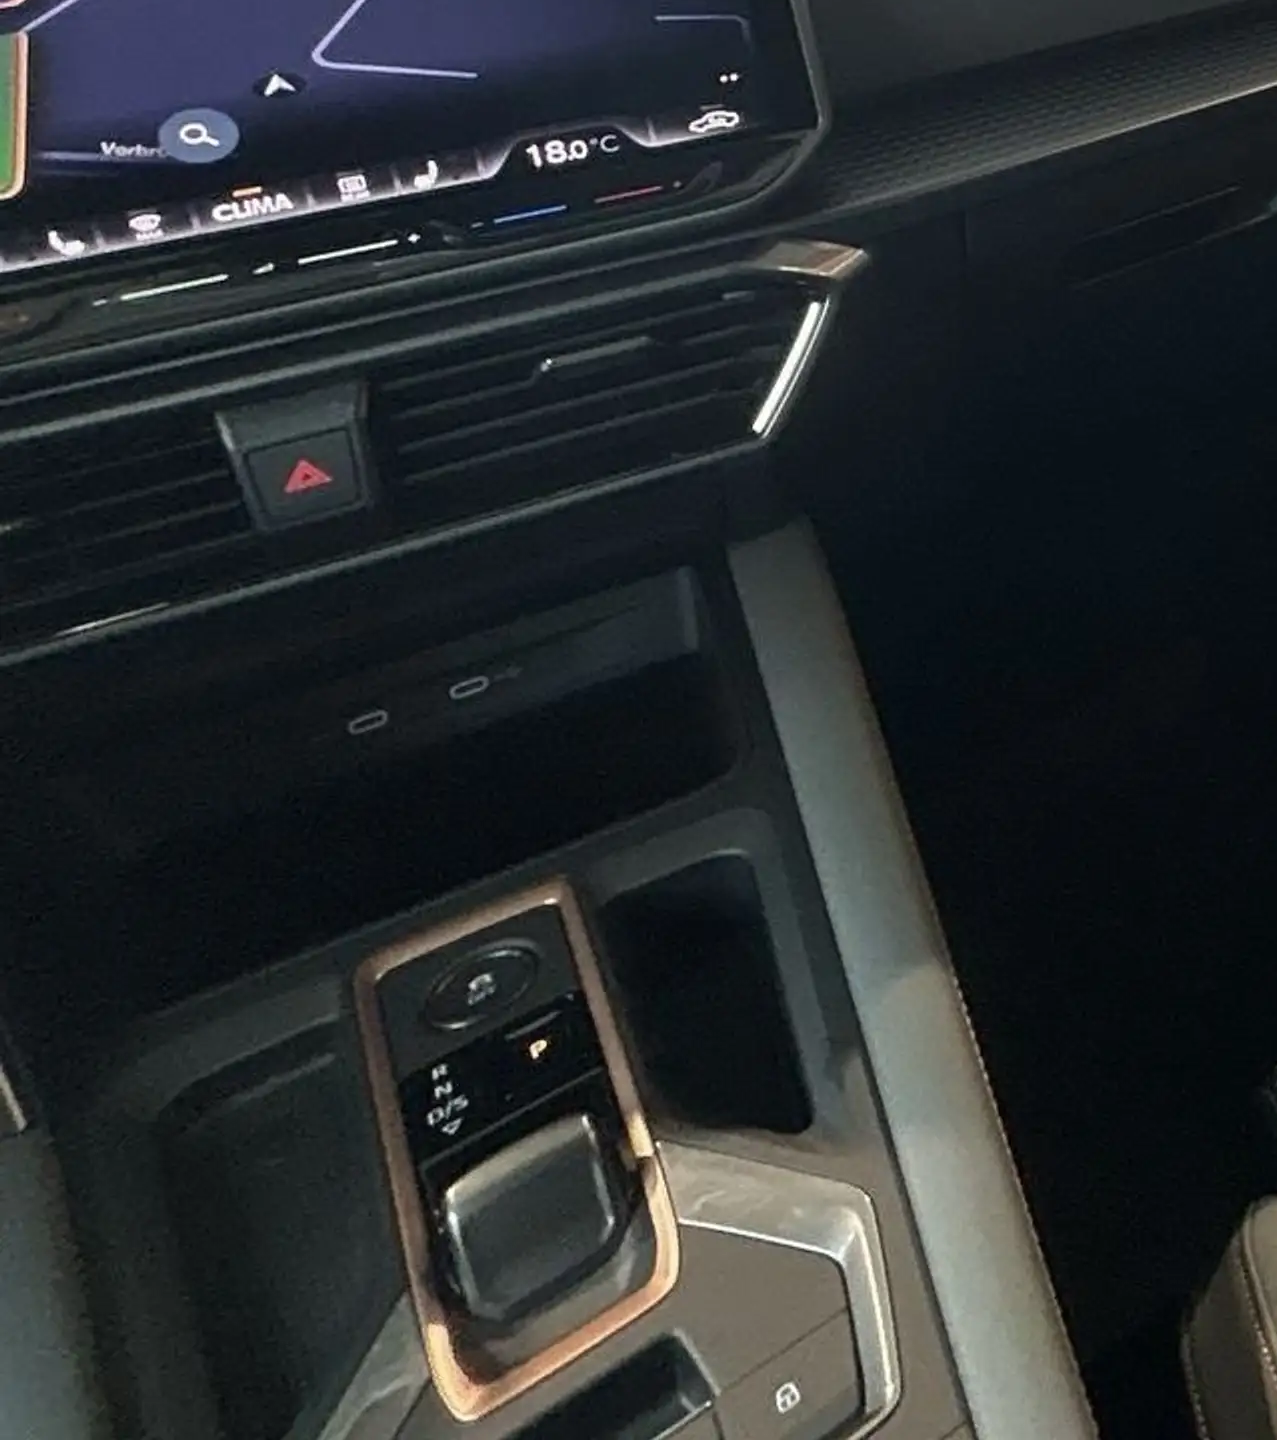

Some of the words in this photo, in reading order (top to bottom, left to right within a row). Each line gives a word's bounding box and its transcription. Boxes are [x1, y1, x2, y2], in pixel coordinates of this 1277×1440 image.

[211, 192, 295, 223] CLIMA
[528, 1039, 548, 1060] P
[431, 1064, 448, 1080] R
[434, 1082, 453, 1099] N
[425, 1095, 471, 1127] D/S
